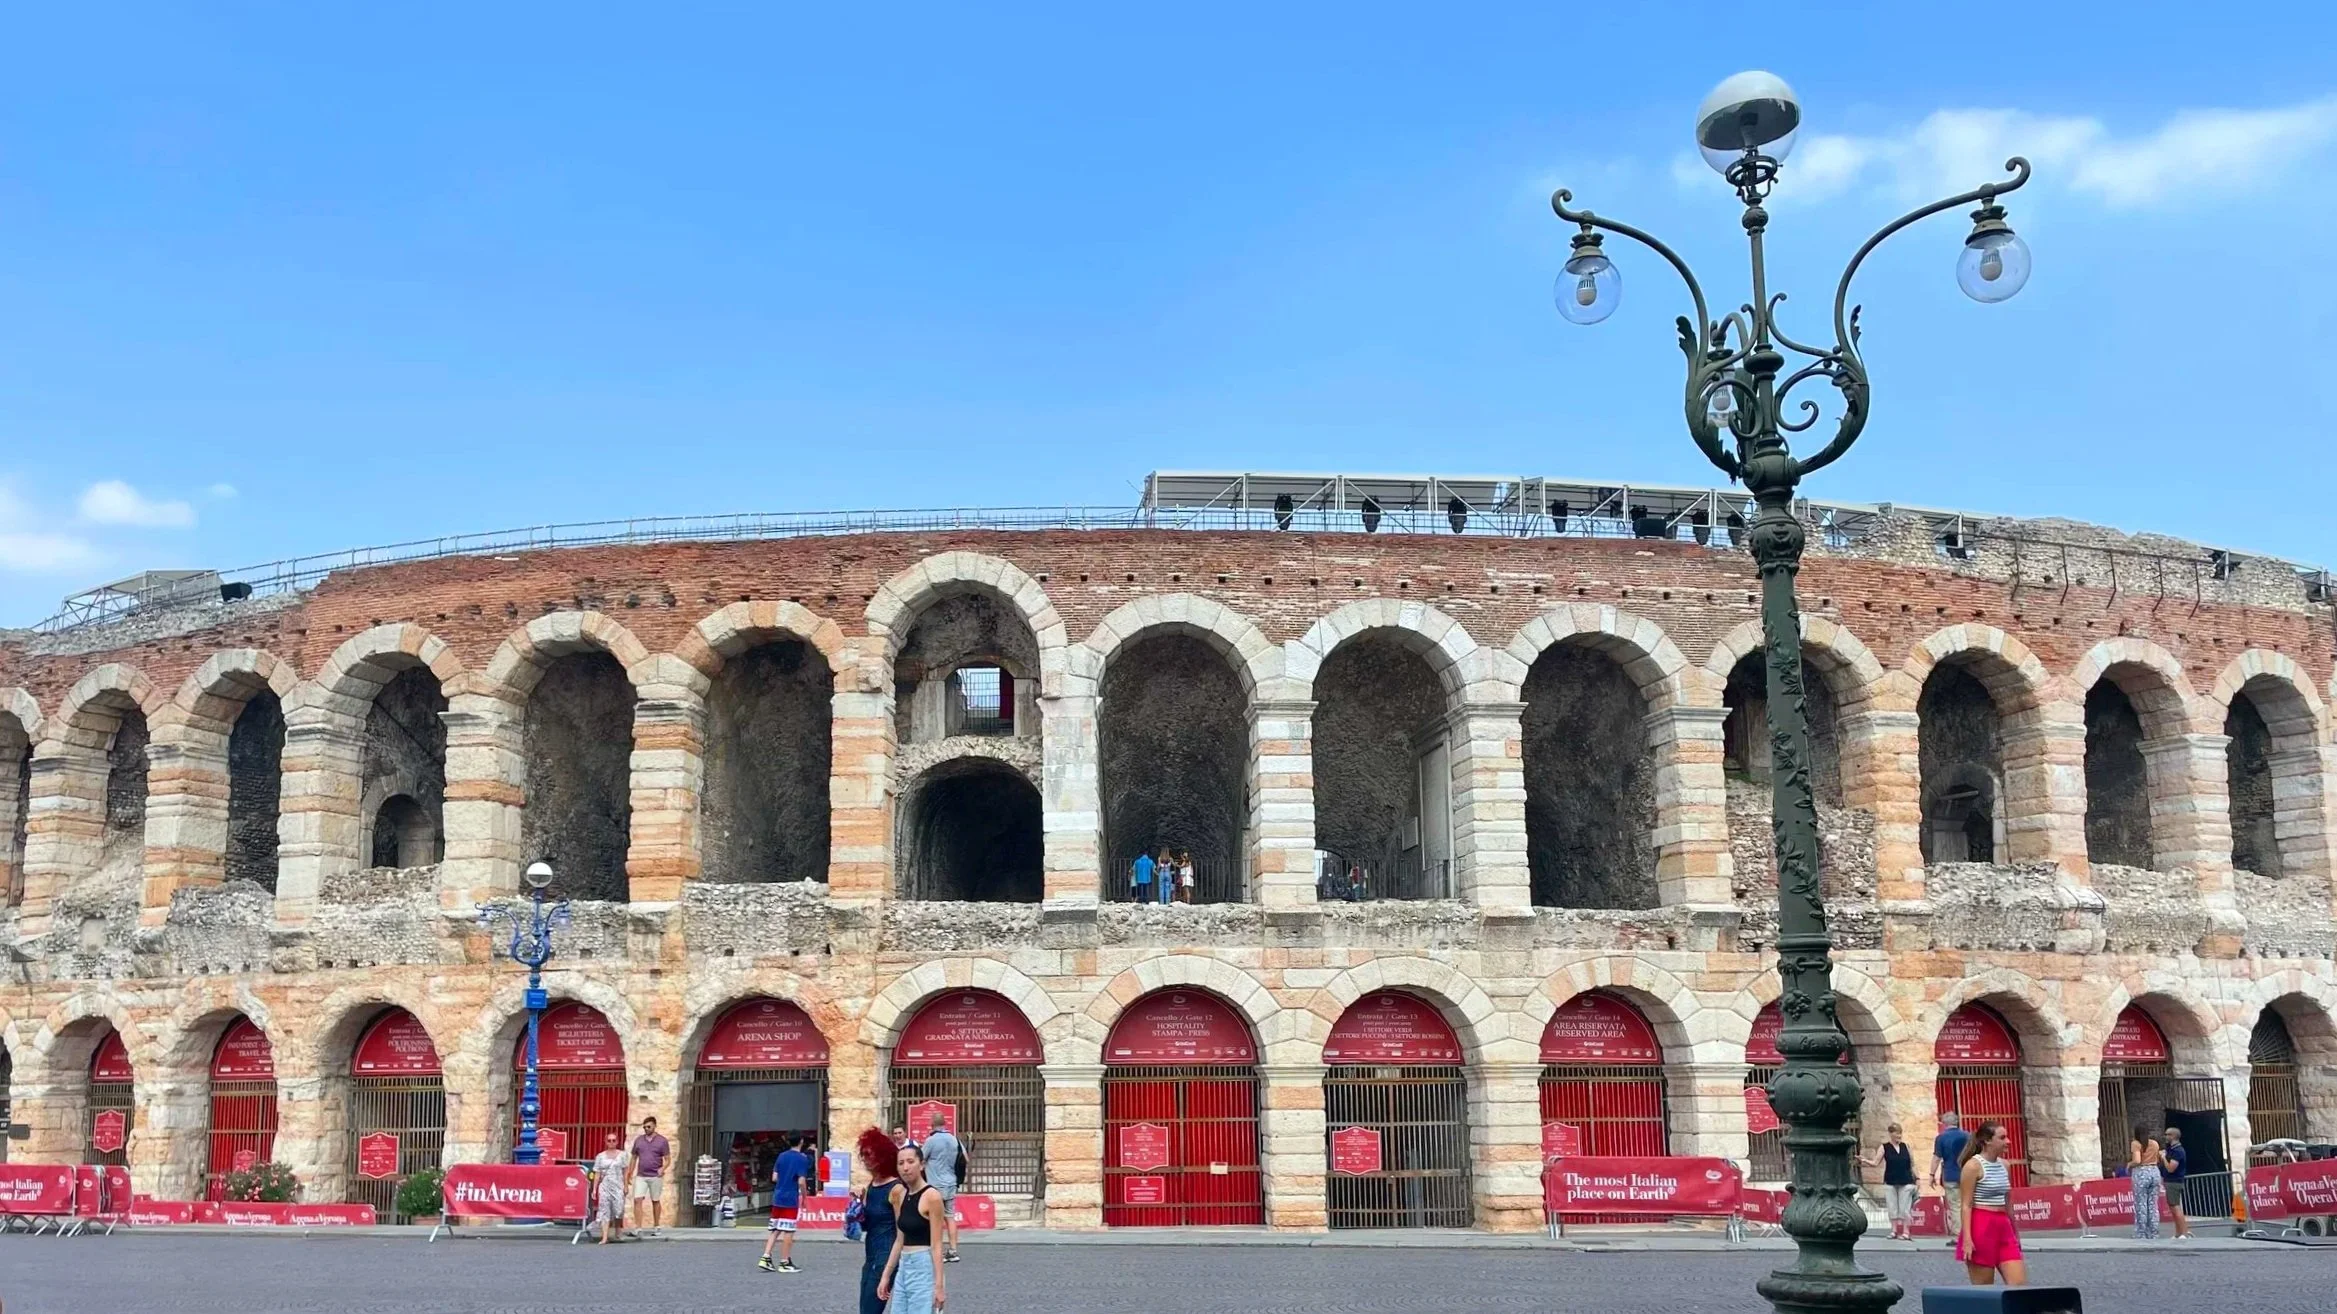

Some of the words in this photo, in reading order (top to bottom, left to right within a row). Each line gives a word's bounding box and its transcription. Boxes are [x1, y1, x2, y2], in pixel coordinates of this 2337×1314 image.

[737, 1033, 772, 1041] ARENA
[774, 1032, 802, 1040] SHOP
[1601, 1030, 1625, 1038] AREA
[15, 1178, 43, 1190] Italian
[1564, 1173, 1591, 1186] The
[1595, 1175, 1627, 1186] most
[1631, 1174, 1677, 1187] Italian
[2287, 1179, 2317, 1191] Arena
[455, 1182, 543, 1203] #inArena
[1567, 1187, 1605, 1202] place
[1607, 1189, 1625, 1199] on
[2250, 1183, 2267, 1195] The
[2085, 1195, 2098, 1204] The
[2099, 1194, 2117, 1203] most
[2118, 1192, 2134, 1202] Itali
[2253, 1195, 2277, 1211] place
[2296, 1188, 2332, 1208] Opera
[2087, 1205, 2109, 1219] place
